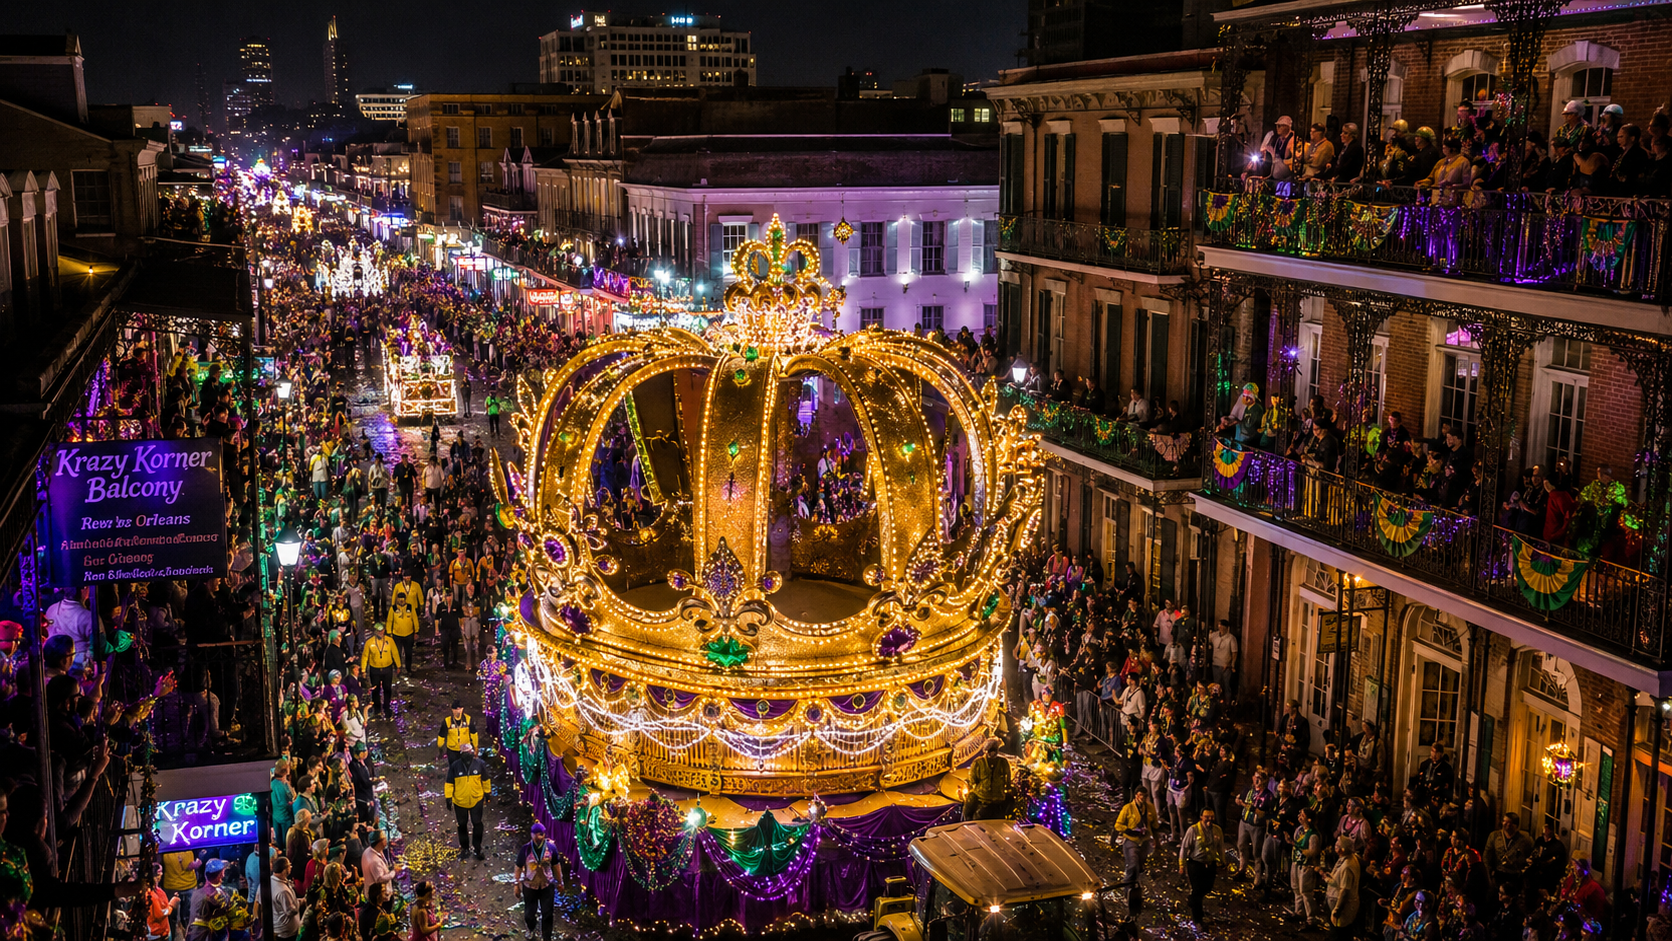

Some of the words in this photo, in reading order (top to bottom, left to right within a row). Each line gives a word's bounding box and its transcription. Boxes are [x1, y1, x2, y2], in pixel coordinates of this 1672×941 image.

[55, 448, 129, 478] Krazy
[132, 445, 212, 474] Korner
[84, 475, 183, 504] Balcony
[135, 513, 191, 528] Orleans
[155, 798, 227, 821] Krazy
[170, 820, 255, 845] Korner
